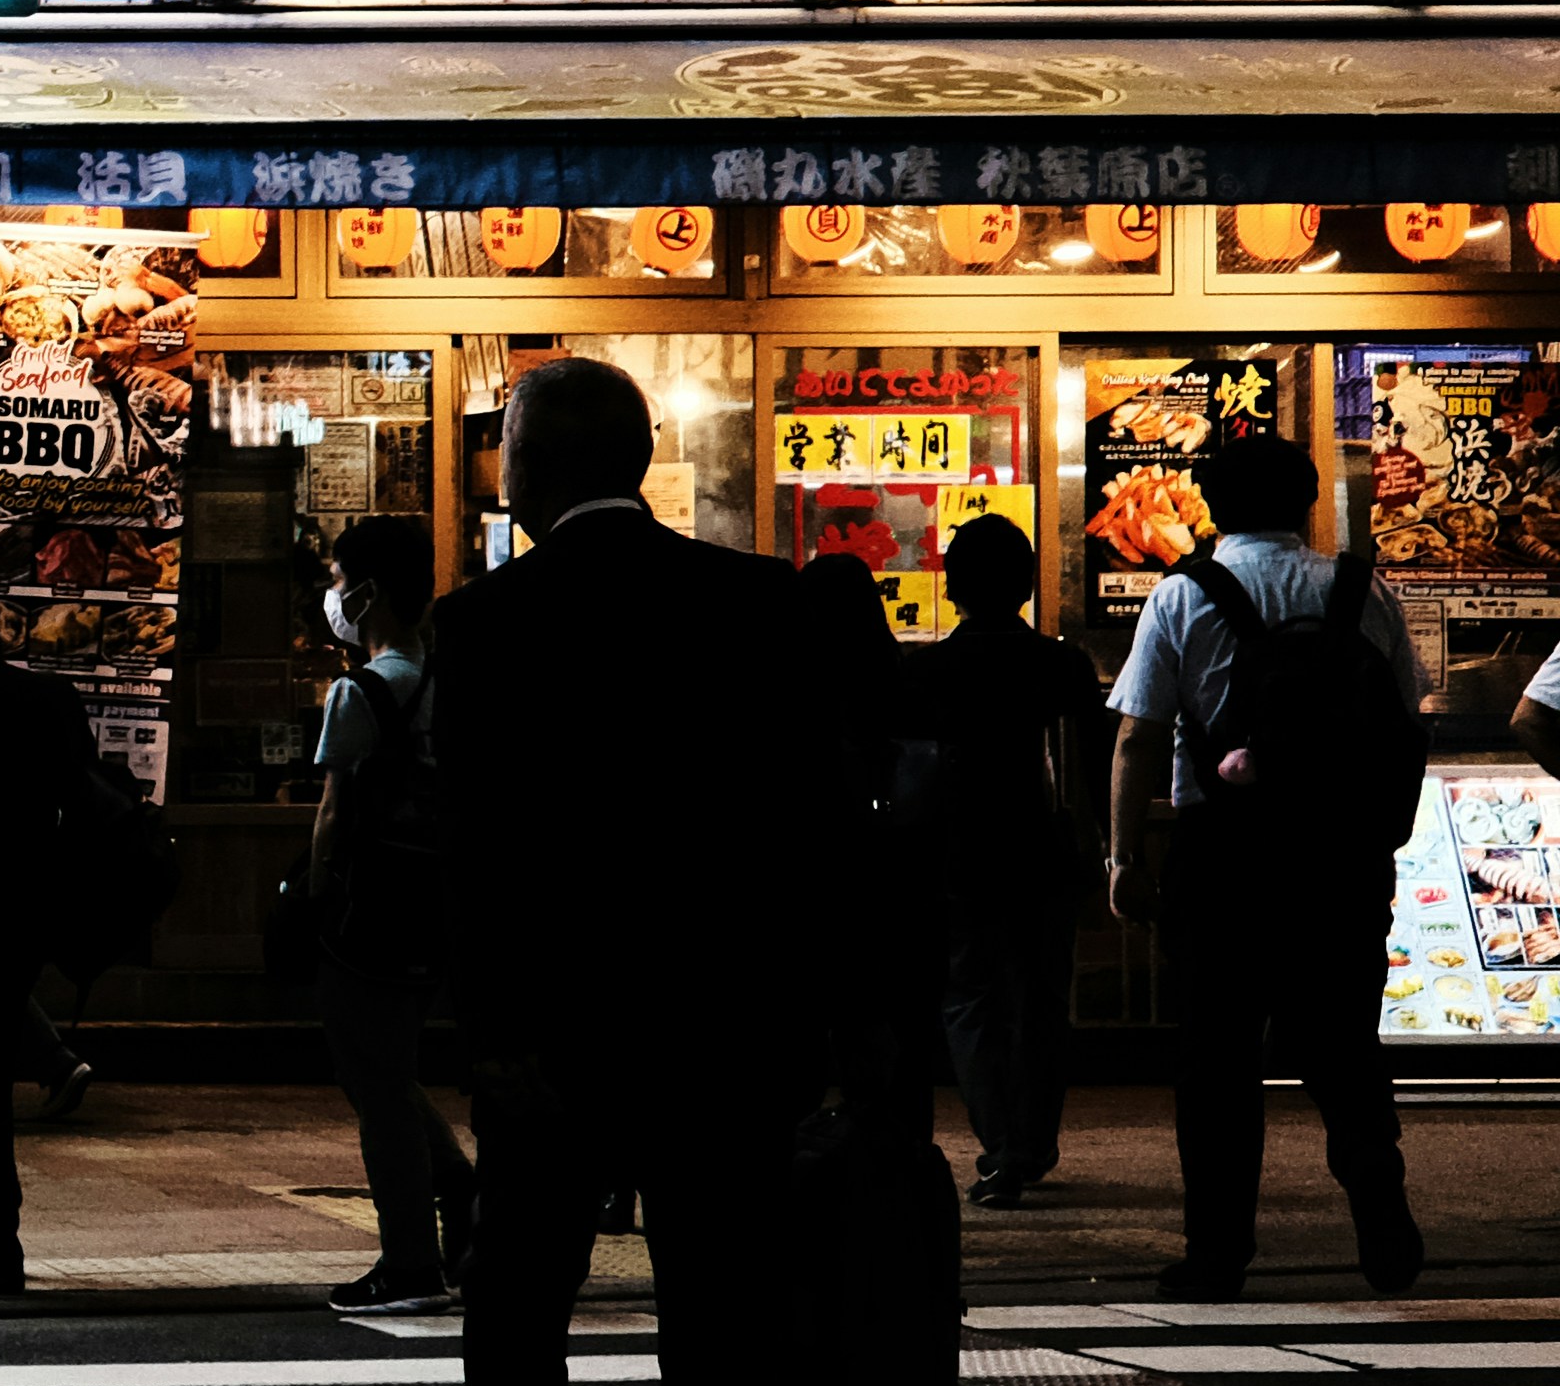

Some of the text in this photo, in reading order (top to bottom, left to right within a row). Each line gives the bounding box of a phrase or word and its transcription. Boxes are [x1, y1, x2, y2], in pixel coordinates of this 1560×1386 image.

[253, 150, 416, 203] 浜焼き
[0, 361, 90, 395] Seafood
[1214, 364, 1274, 420] 焼
[1447, 397, 1492, 417] BBQ
[782, 419, 950, 472] 営業時間
[1451, 418, 1492, 502] 浜焼
[19, 475, 71, 495] enjoy
[73, 477, 144, 495] cooking
[99, 682, 162, 697] available
